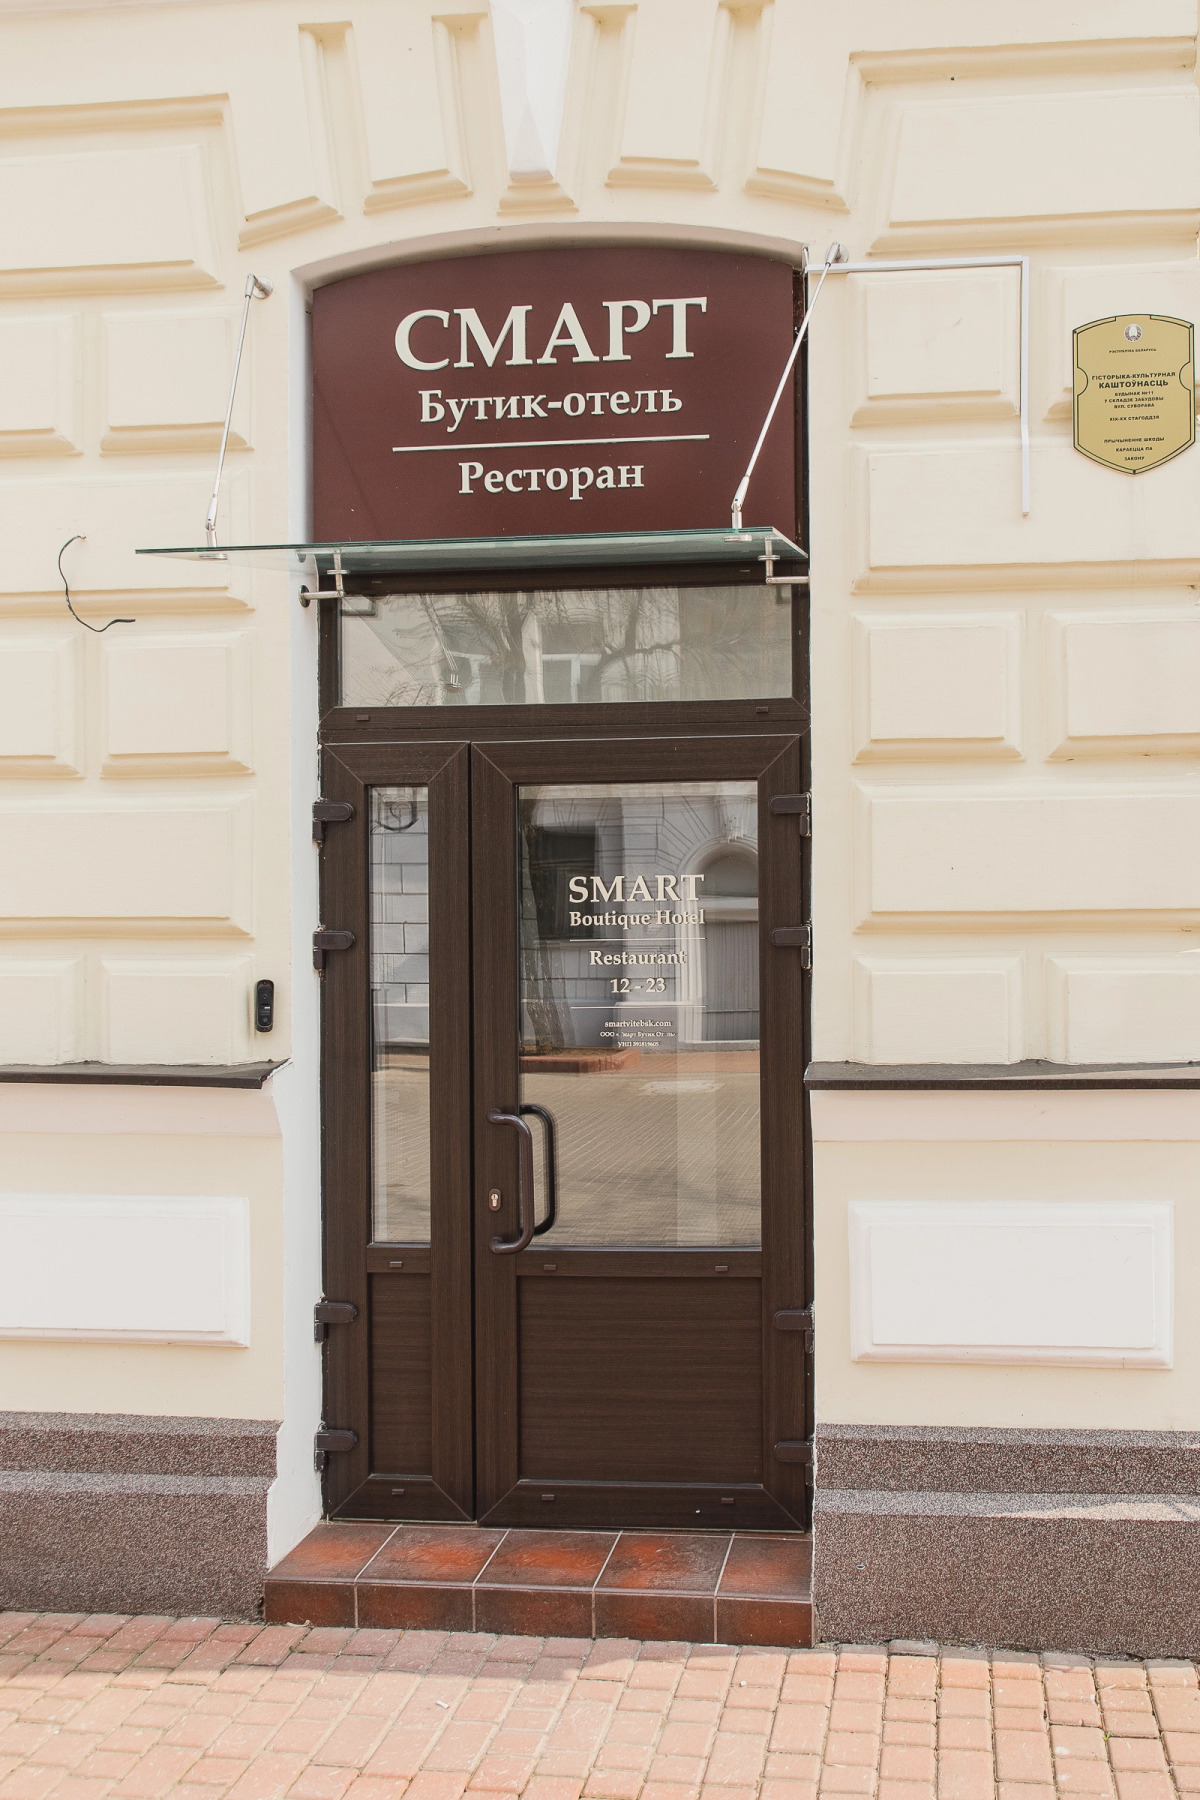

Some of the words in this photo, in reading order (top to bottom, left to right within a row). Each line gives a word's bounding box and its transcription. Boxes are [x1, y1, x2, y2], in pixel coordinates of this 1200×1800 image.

[394, 296, 707, 371] СМАРТ
[1091, 372, 1176, 380] ГІСТОРЫКА-КУЛЬТУРНАЯ
[1098, 380, 1169, 389] КАШТОЎНАСЦЬ
[417, 389, 683, 433] Бутик-отель
[458, 461, 645, 500] Ресторан
[568, 874, 705, 904] SMART
[569, 910, 651, 930] Boutique
[656, 908, 706, 925] Hotel
[589, 950, 687, 966] Restaurant
[610, 978, 630, 993] 12
[645, 977, 666, 993] 23
[604, 1019, 672, 1028] smartvitebsk.com
